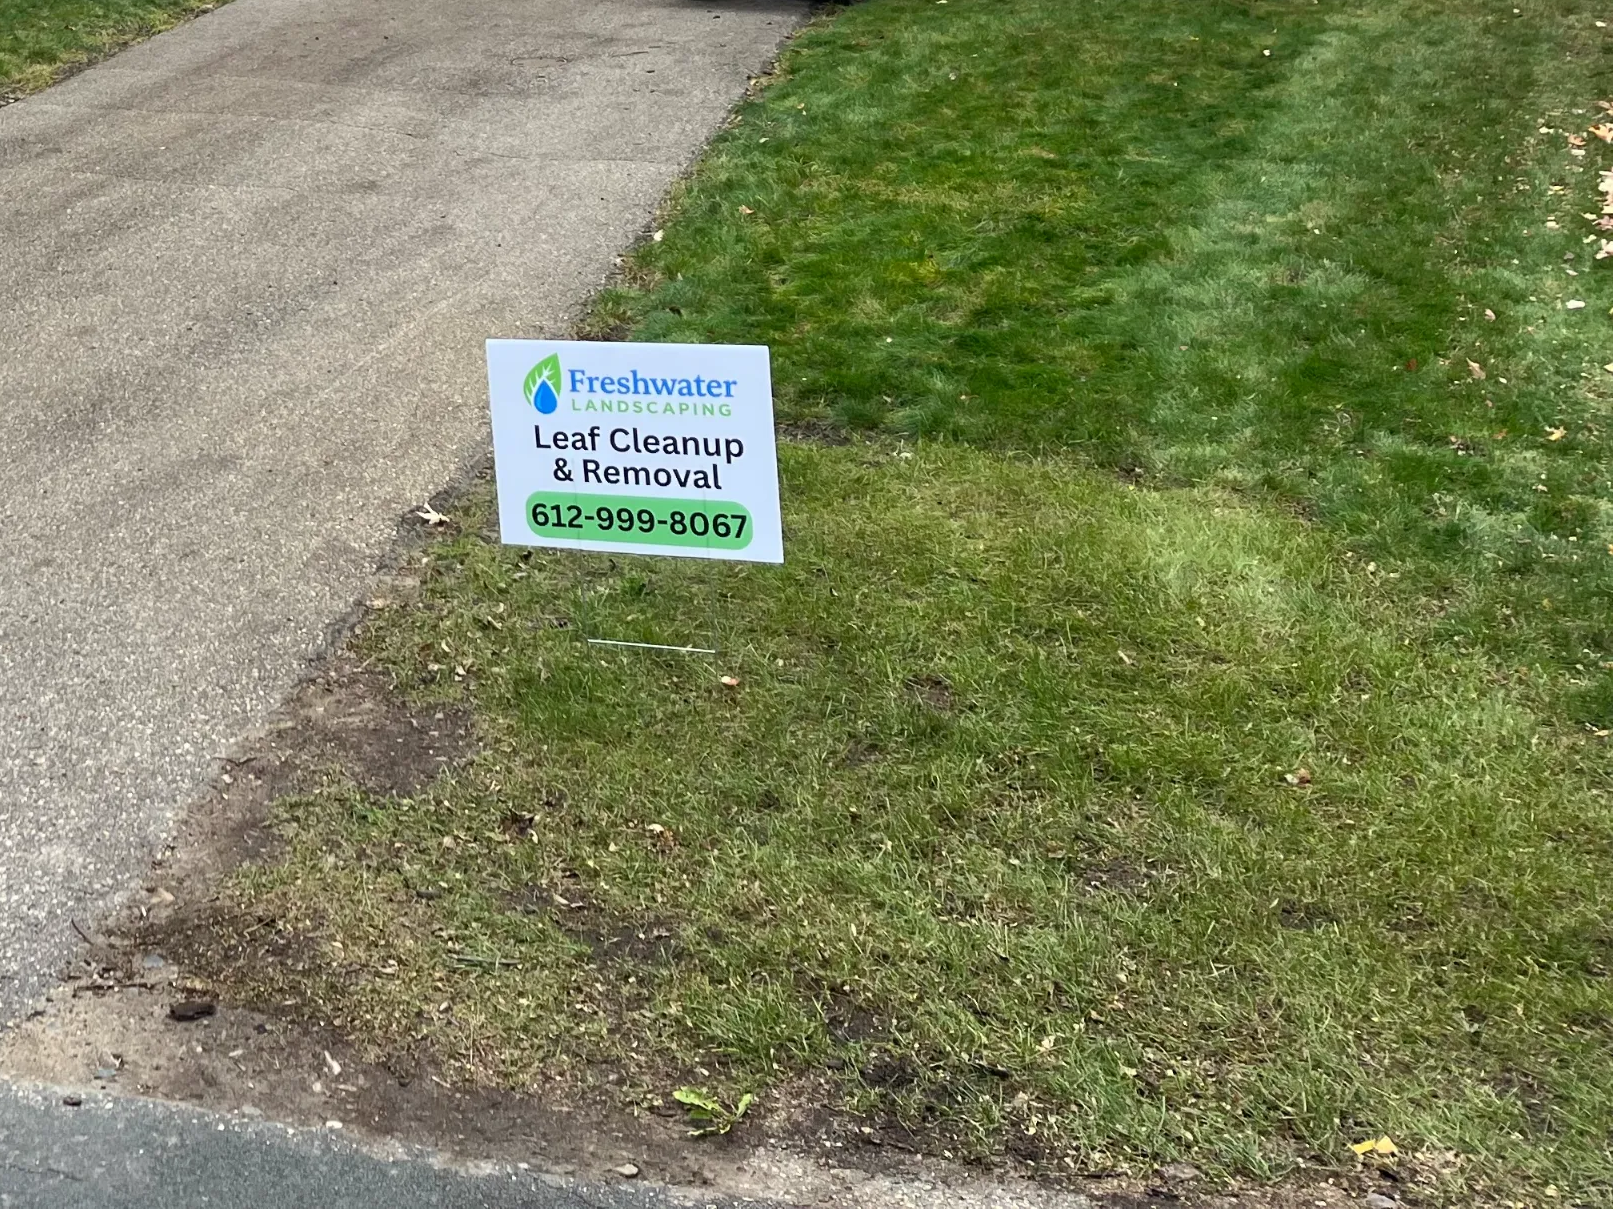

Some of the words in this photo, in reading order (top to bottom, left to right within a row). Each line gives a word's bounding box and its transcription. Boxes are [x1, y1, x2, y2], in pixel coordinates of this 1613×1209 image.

[568, 369, 737, 398] Freshwater
[572, 398, 732, 417] LANDSCAPING
[534, 425, 600, 451] Leaf
[609, 427, 745, 464] Cleanup
[553, 457, 574, 482] &
[583, 459, 722, 490] Removal
[531, 503, 748, 539] 612-999-8067
